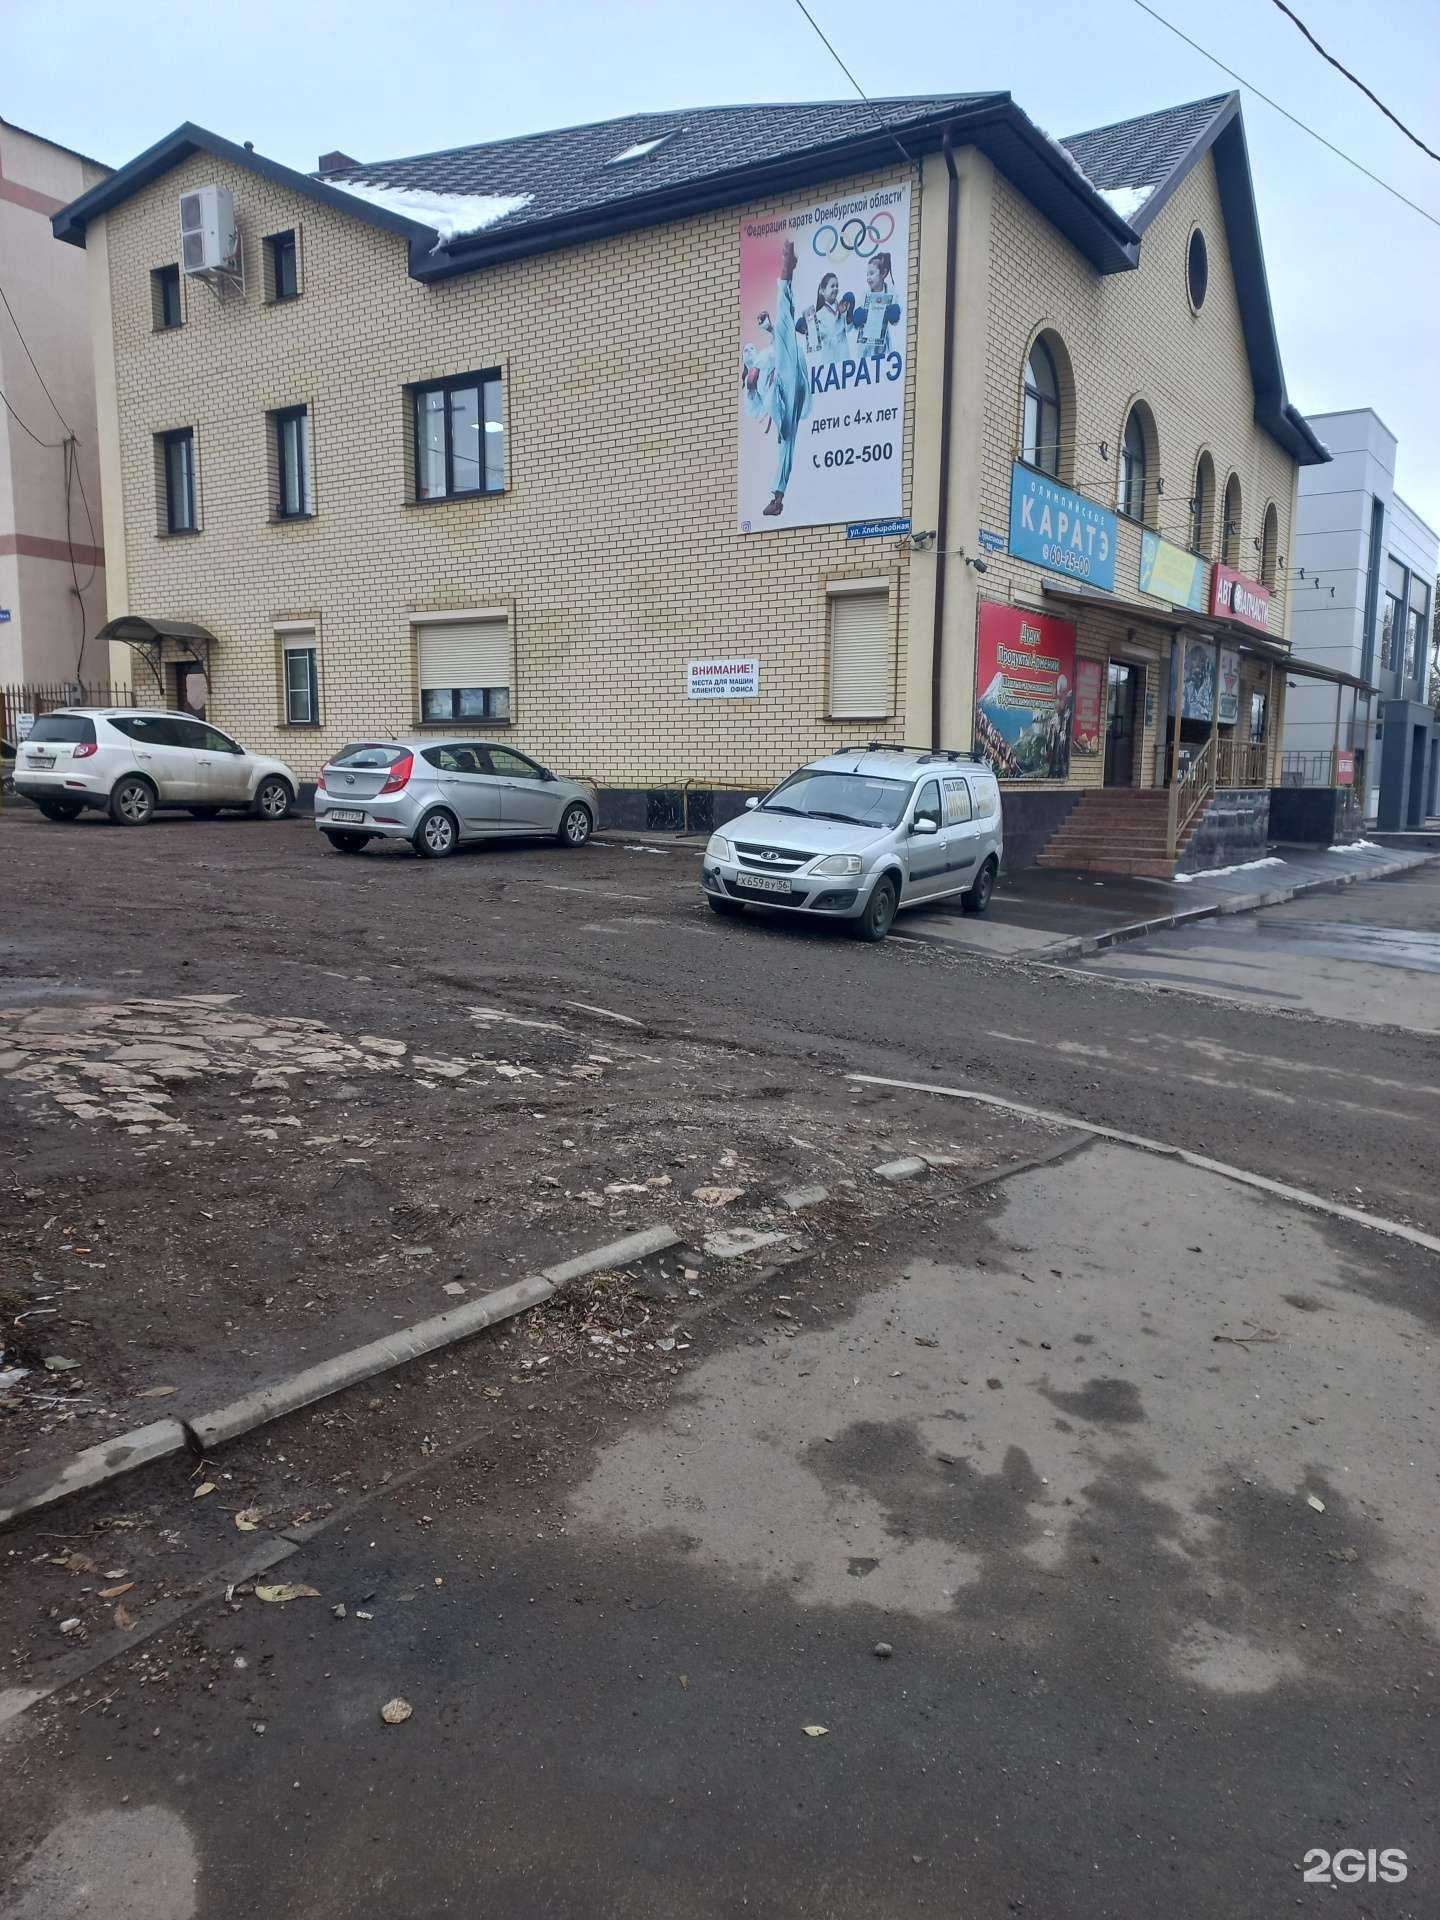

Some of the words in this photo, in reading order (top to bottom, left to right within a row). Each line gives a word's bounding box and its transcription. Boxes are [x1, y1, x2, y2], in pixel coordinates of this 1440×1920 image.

[789, 213, 813, 231] карате
[814, 197, 868, 224] Оренбургской
[811, 351, 903, 394] КАРАТЭ
[811, 417, 840, 434] дети
[843, 415, 851, 427] с
[853, 409, 872, 425] 4-х
[876, 407, 898, 422] лет
[824, 442, 893, 468] 602-500
[850, 529, 861, 538] ул.
[1021, 494, 1110, 562] КАРАТЭ
[1050, 544, 1090, 577] 60-25-00
[692, 663, 754, 676] ВНИМАНИЕ!
[997, 644, 1029, 670] Продукты
[692, 686, 725, 694] КЛИЕНТОВ
[714, 678, 728, 686] ДЛЯ
[729, 677, 754, 685] МАШИН
